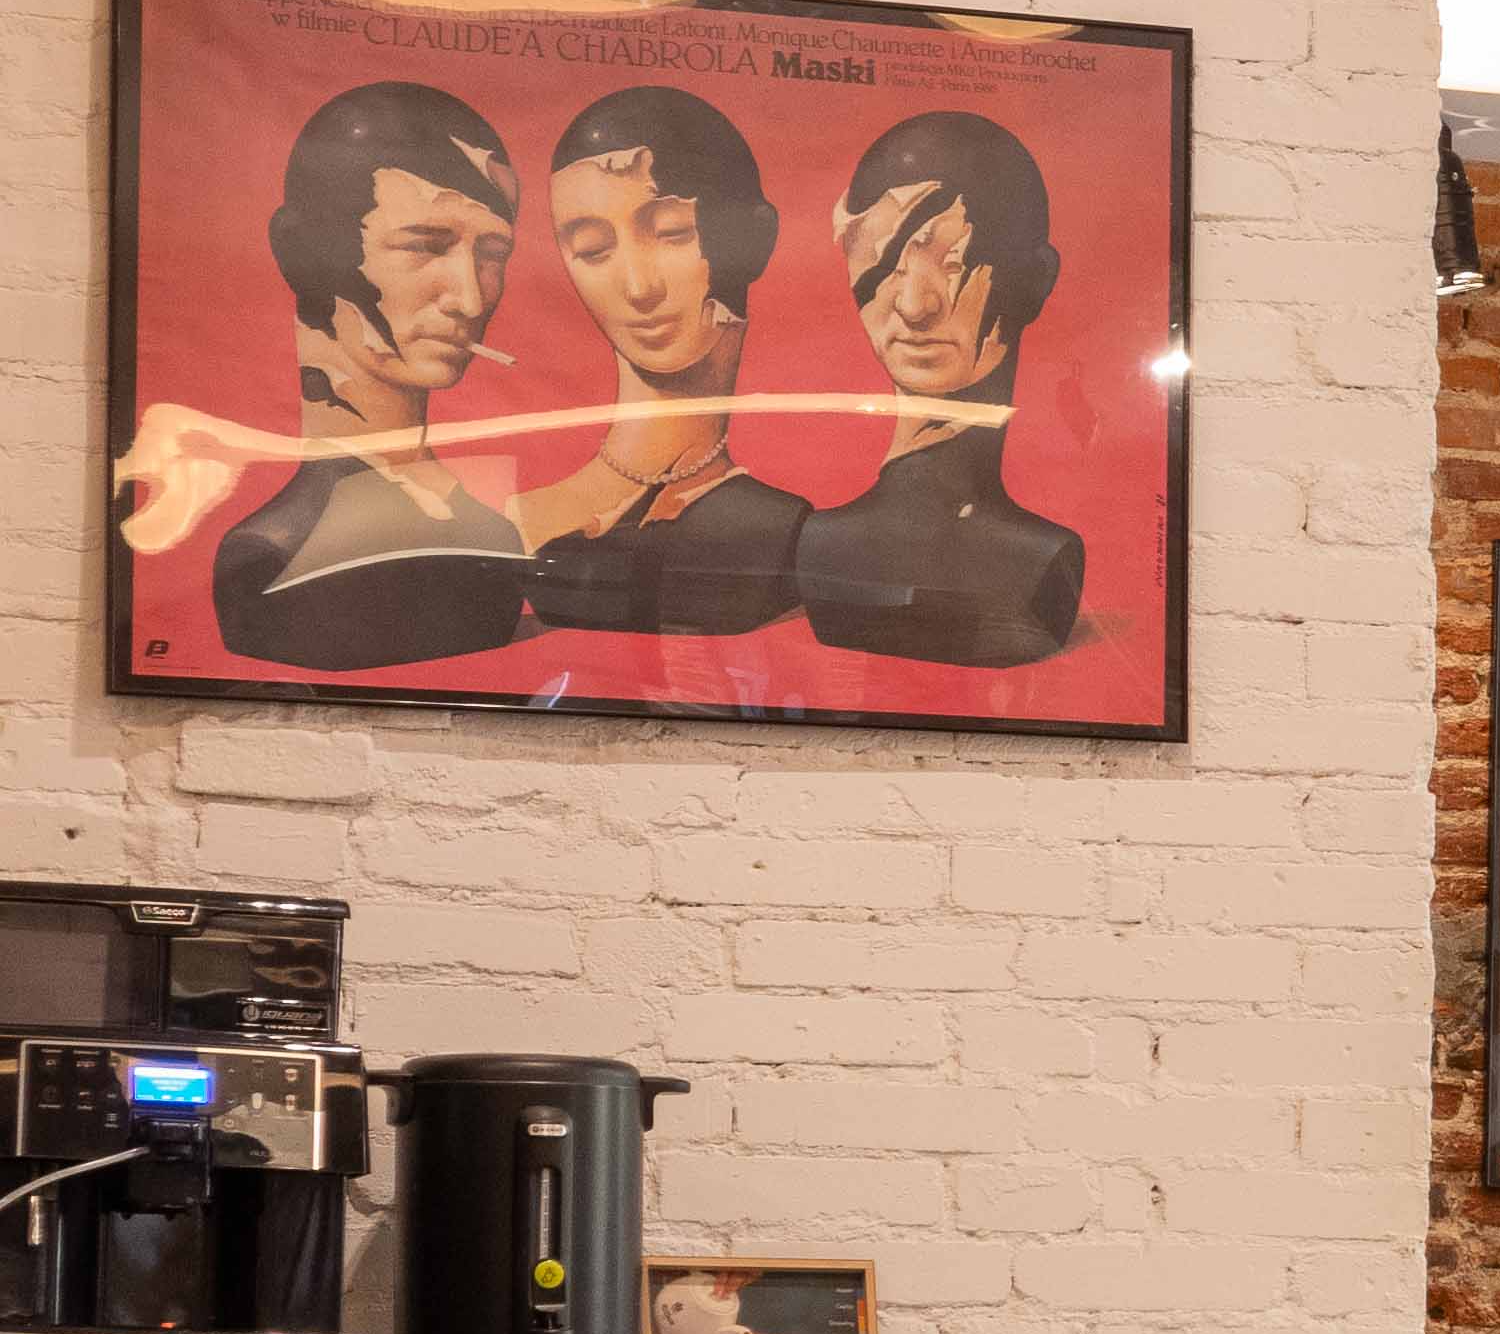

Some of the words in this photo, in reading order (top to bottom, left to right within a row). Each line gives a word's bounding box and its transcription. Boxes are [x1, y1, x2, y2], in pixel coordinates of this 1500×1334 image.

[271, 12, 291, 28] w
[297, 8, 357, 33] filmie
[556, 32, 758, 76] CHABROLA
[771, 49, 877, 85] Maski
[737, 22, 829, 51] Monique
[832, 28, 945, 58] Chaumette
[961, 42, 1017, 64] Anne
[1020, 45, 1098, 72] Brochet
